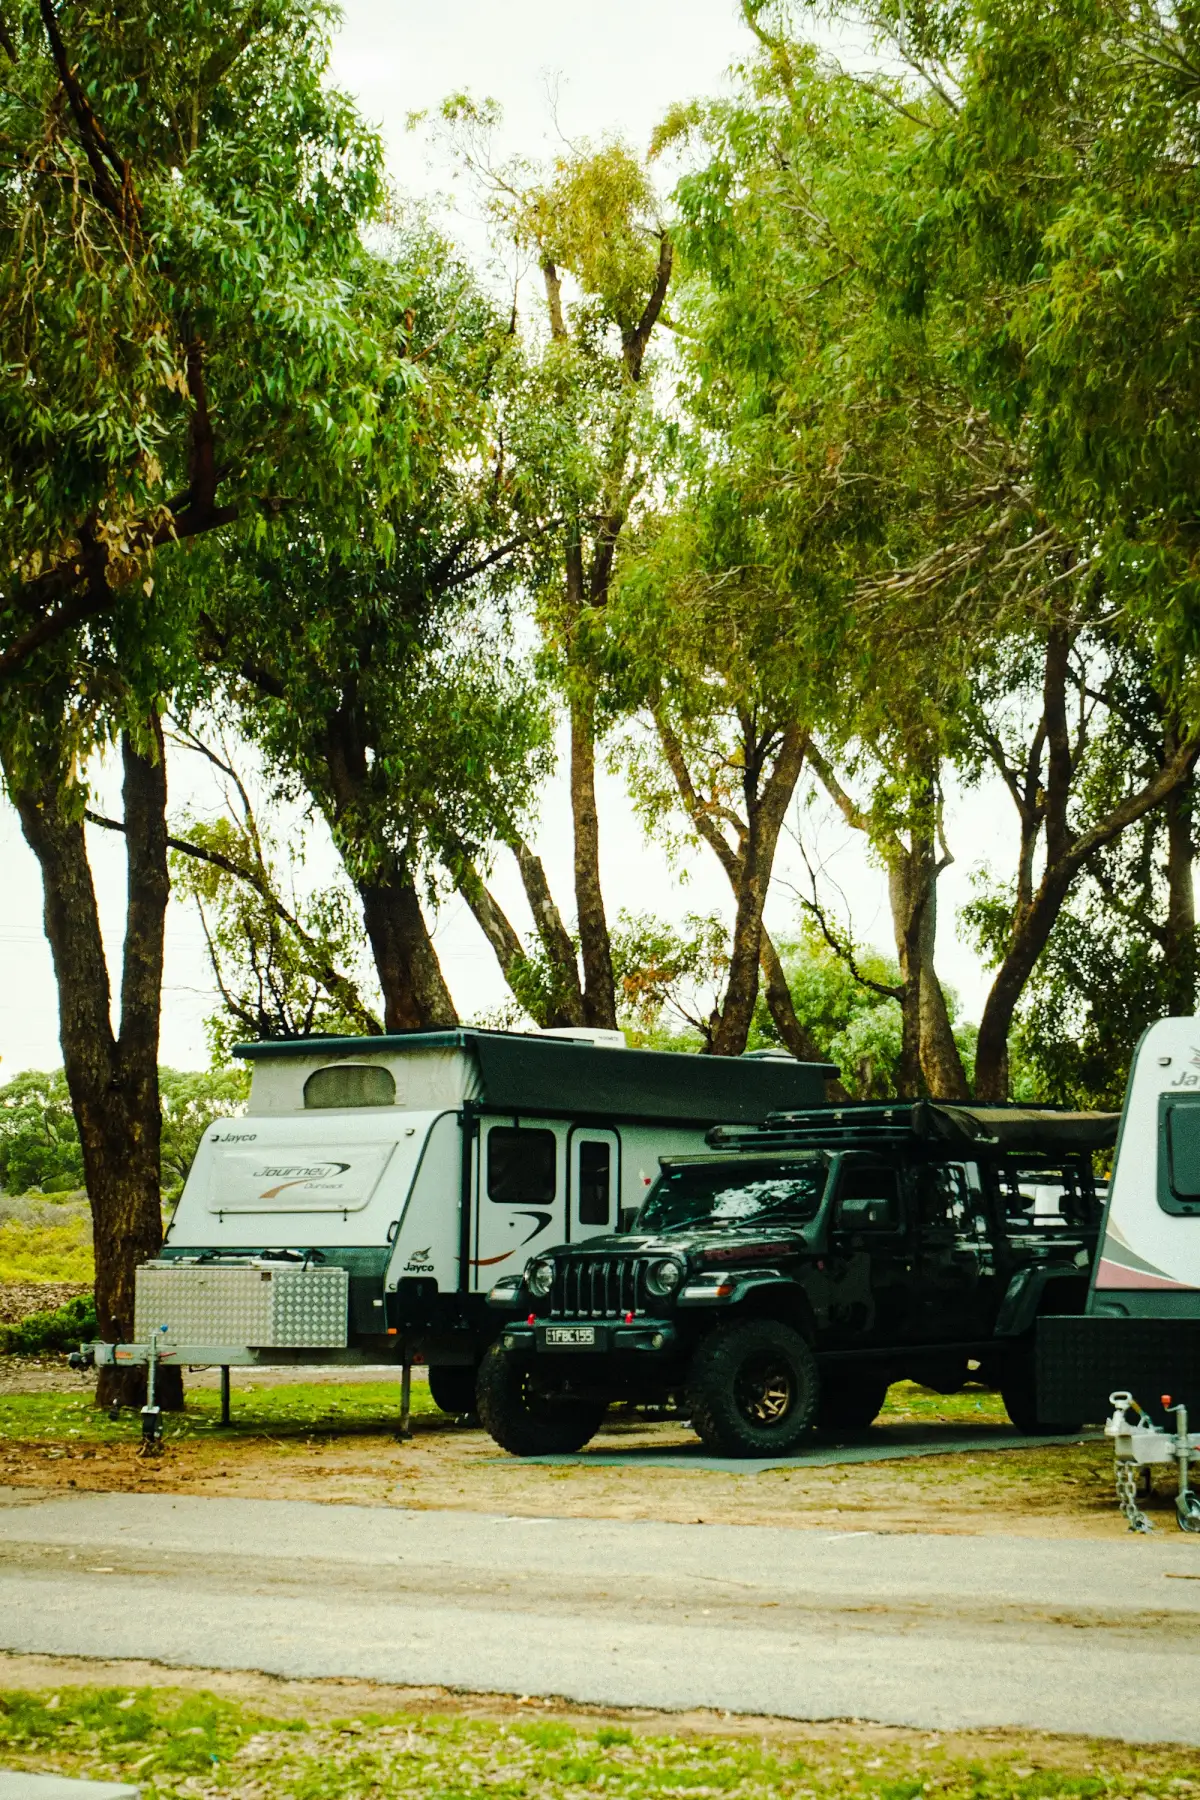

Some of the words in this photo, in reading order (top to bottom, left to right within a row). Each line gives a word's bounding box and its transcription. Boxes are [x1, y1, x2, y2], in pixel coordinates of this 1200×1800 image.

[1171, 1071, 1200, 1089] Ja
[221, 1133, 257, 1144] Jayco
[253, 1165, 332, 1179] Journey
[403, 1262, 434, 1273] Jayco
